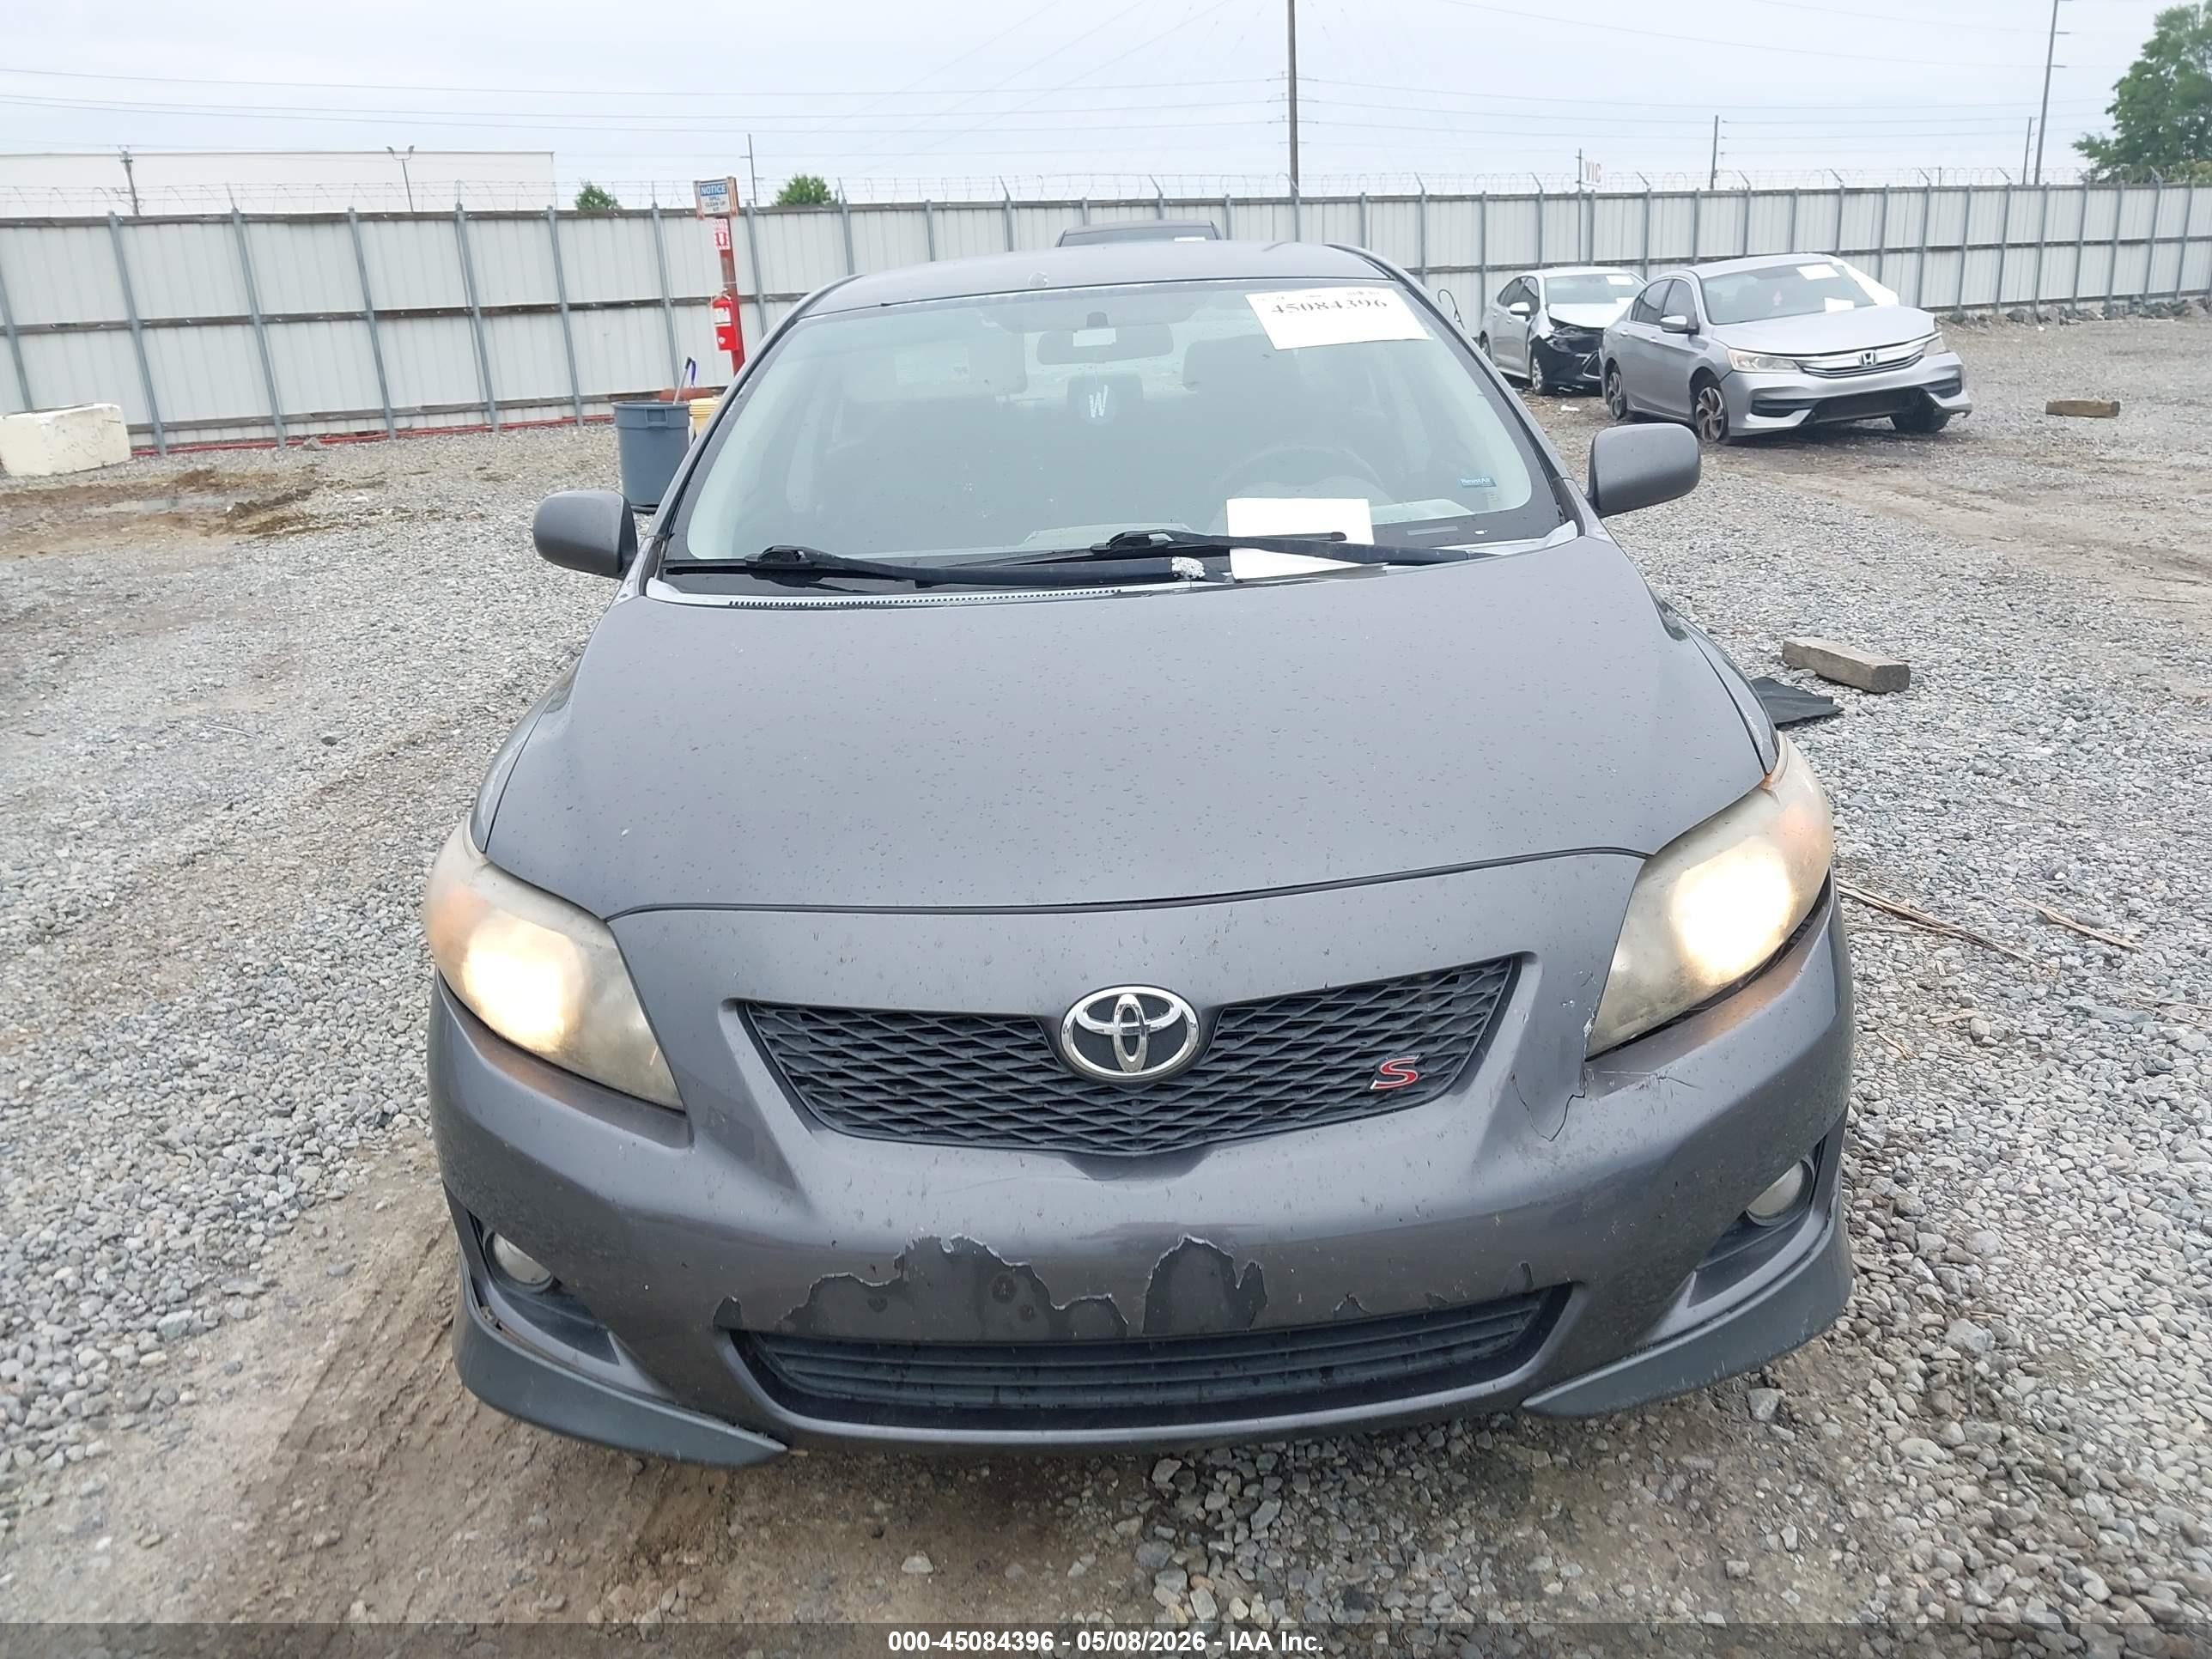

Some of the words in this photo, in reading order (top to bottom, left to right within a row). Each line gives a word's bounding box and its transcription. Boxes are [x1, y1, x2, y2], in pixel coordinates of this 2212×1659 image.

[701, 184, 726, 195] NOTICE
[1272, 299, 1388, 314] 45084396
[1370, 1054, 1419, 1091] S
